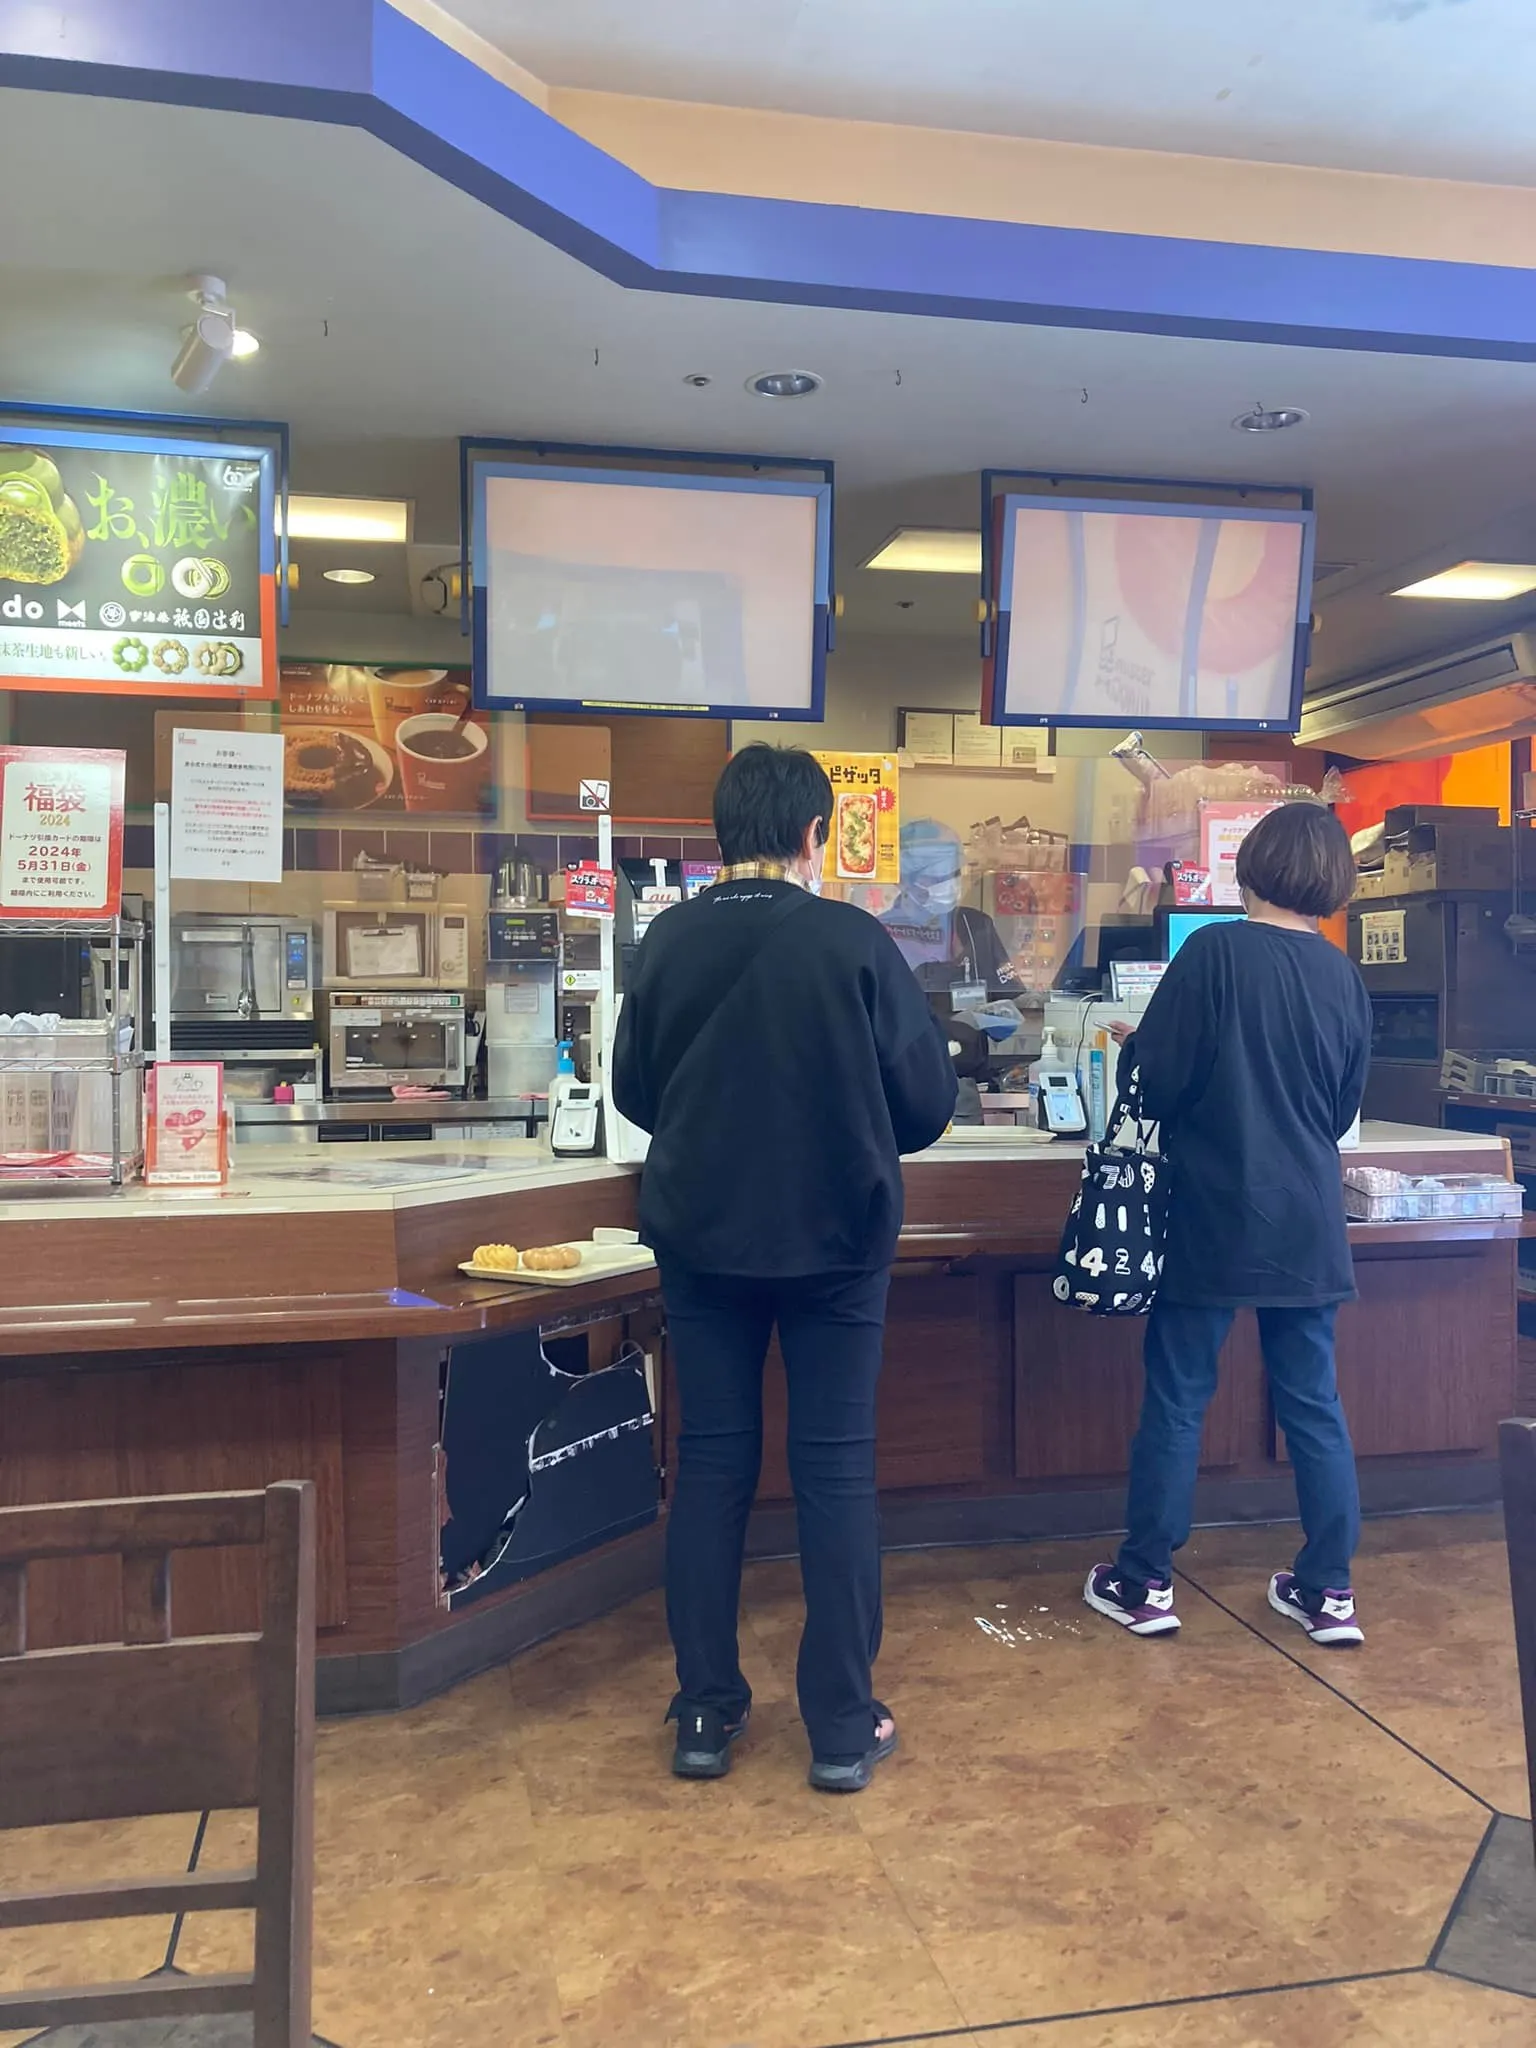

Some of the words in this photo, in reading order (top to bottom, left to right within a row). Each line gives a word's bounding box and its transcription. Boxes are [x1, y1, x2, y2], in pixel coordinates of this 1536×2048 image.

[23, 782, 87, 813] 福袋
[40, 814, 71, 826] 2024
[28, 845, 82, 857] 2024年
